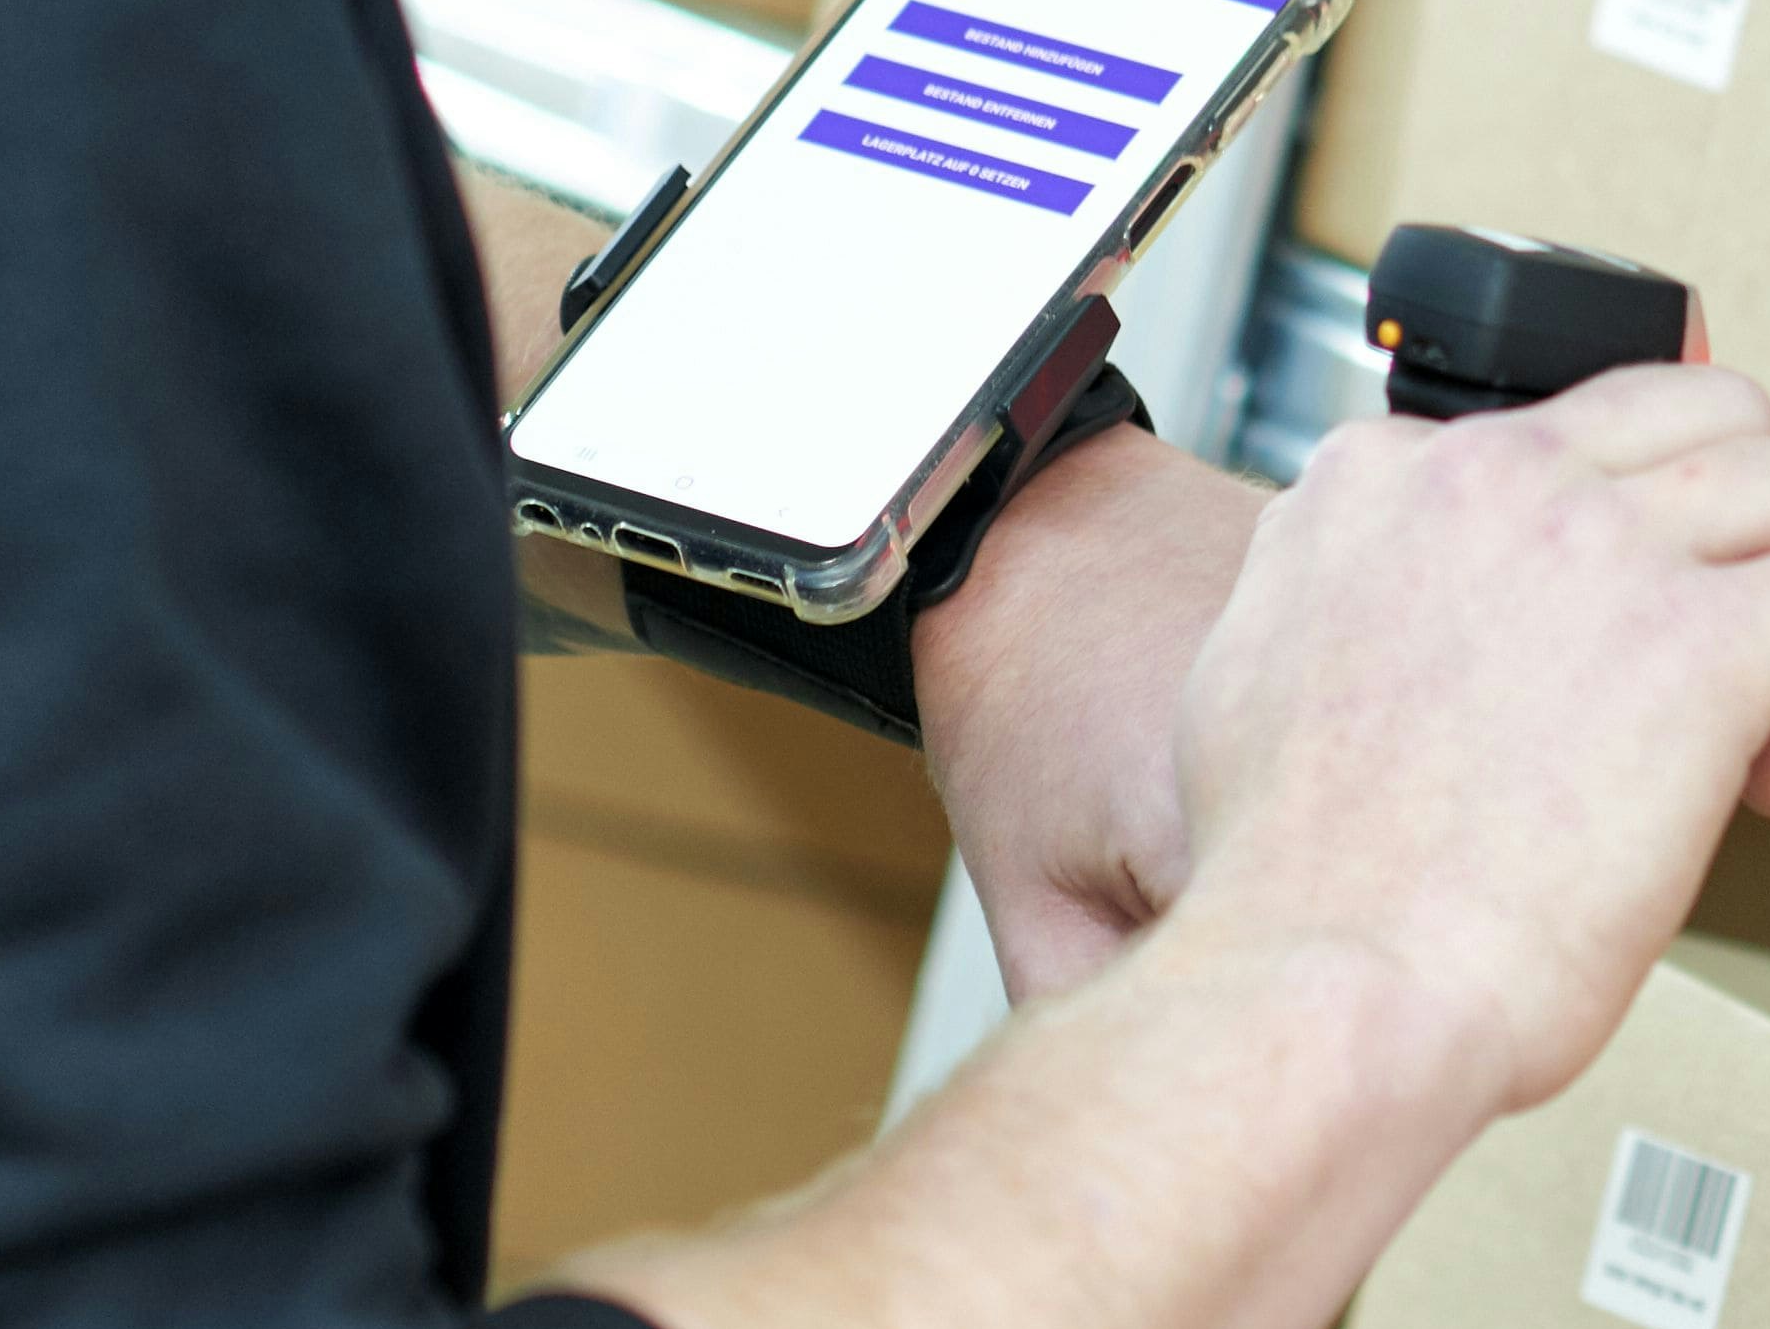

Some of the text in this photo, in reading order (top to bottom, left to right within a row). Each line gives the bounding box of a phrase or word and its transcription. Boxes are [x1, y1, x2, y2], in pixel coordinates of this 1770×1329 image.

[963, 27, 1105, 77] BESTAND HINZUFÜGEN
[922, 84, 1058, 131] BESTAND ENTFERNEN
[861, 133, 1031, 191] LAGERPLATZ AUF 0 SETZEN
